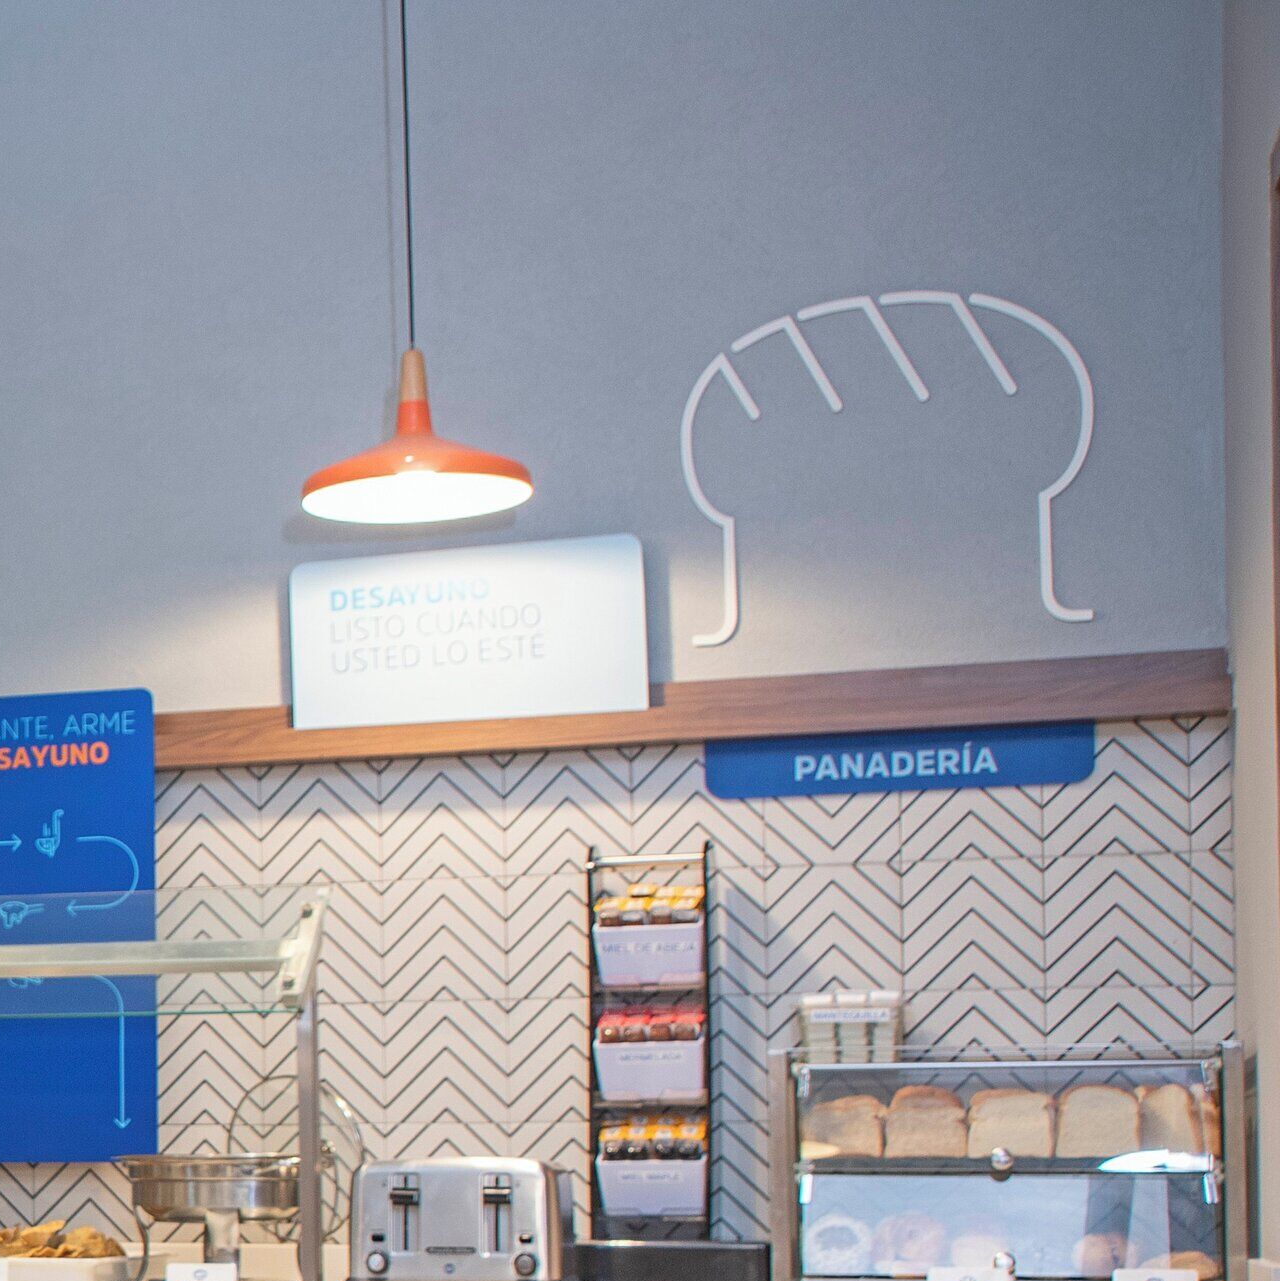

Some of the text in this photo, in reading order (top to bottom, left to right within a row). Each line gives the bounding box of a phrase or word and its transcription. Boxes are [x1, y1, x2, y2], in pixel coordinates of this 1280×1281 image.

[329, 577, 490, 612] DESAYUNO
[330, 603, 542, 645] LISTO CUANDO
[331, 644, 422, 675] USTED
[433, 640, 470, 667] LO
[63, 710, 136, 738] ARME
[793, 741, 999, 782] PANADERÍA
